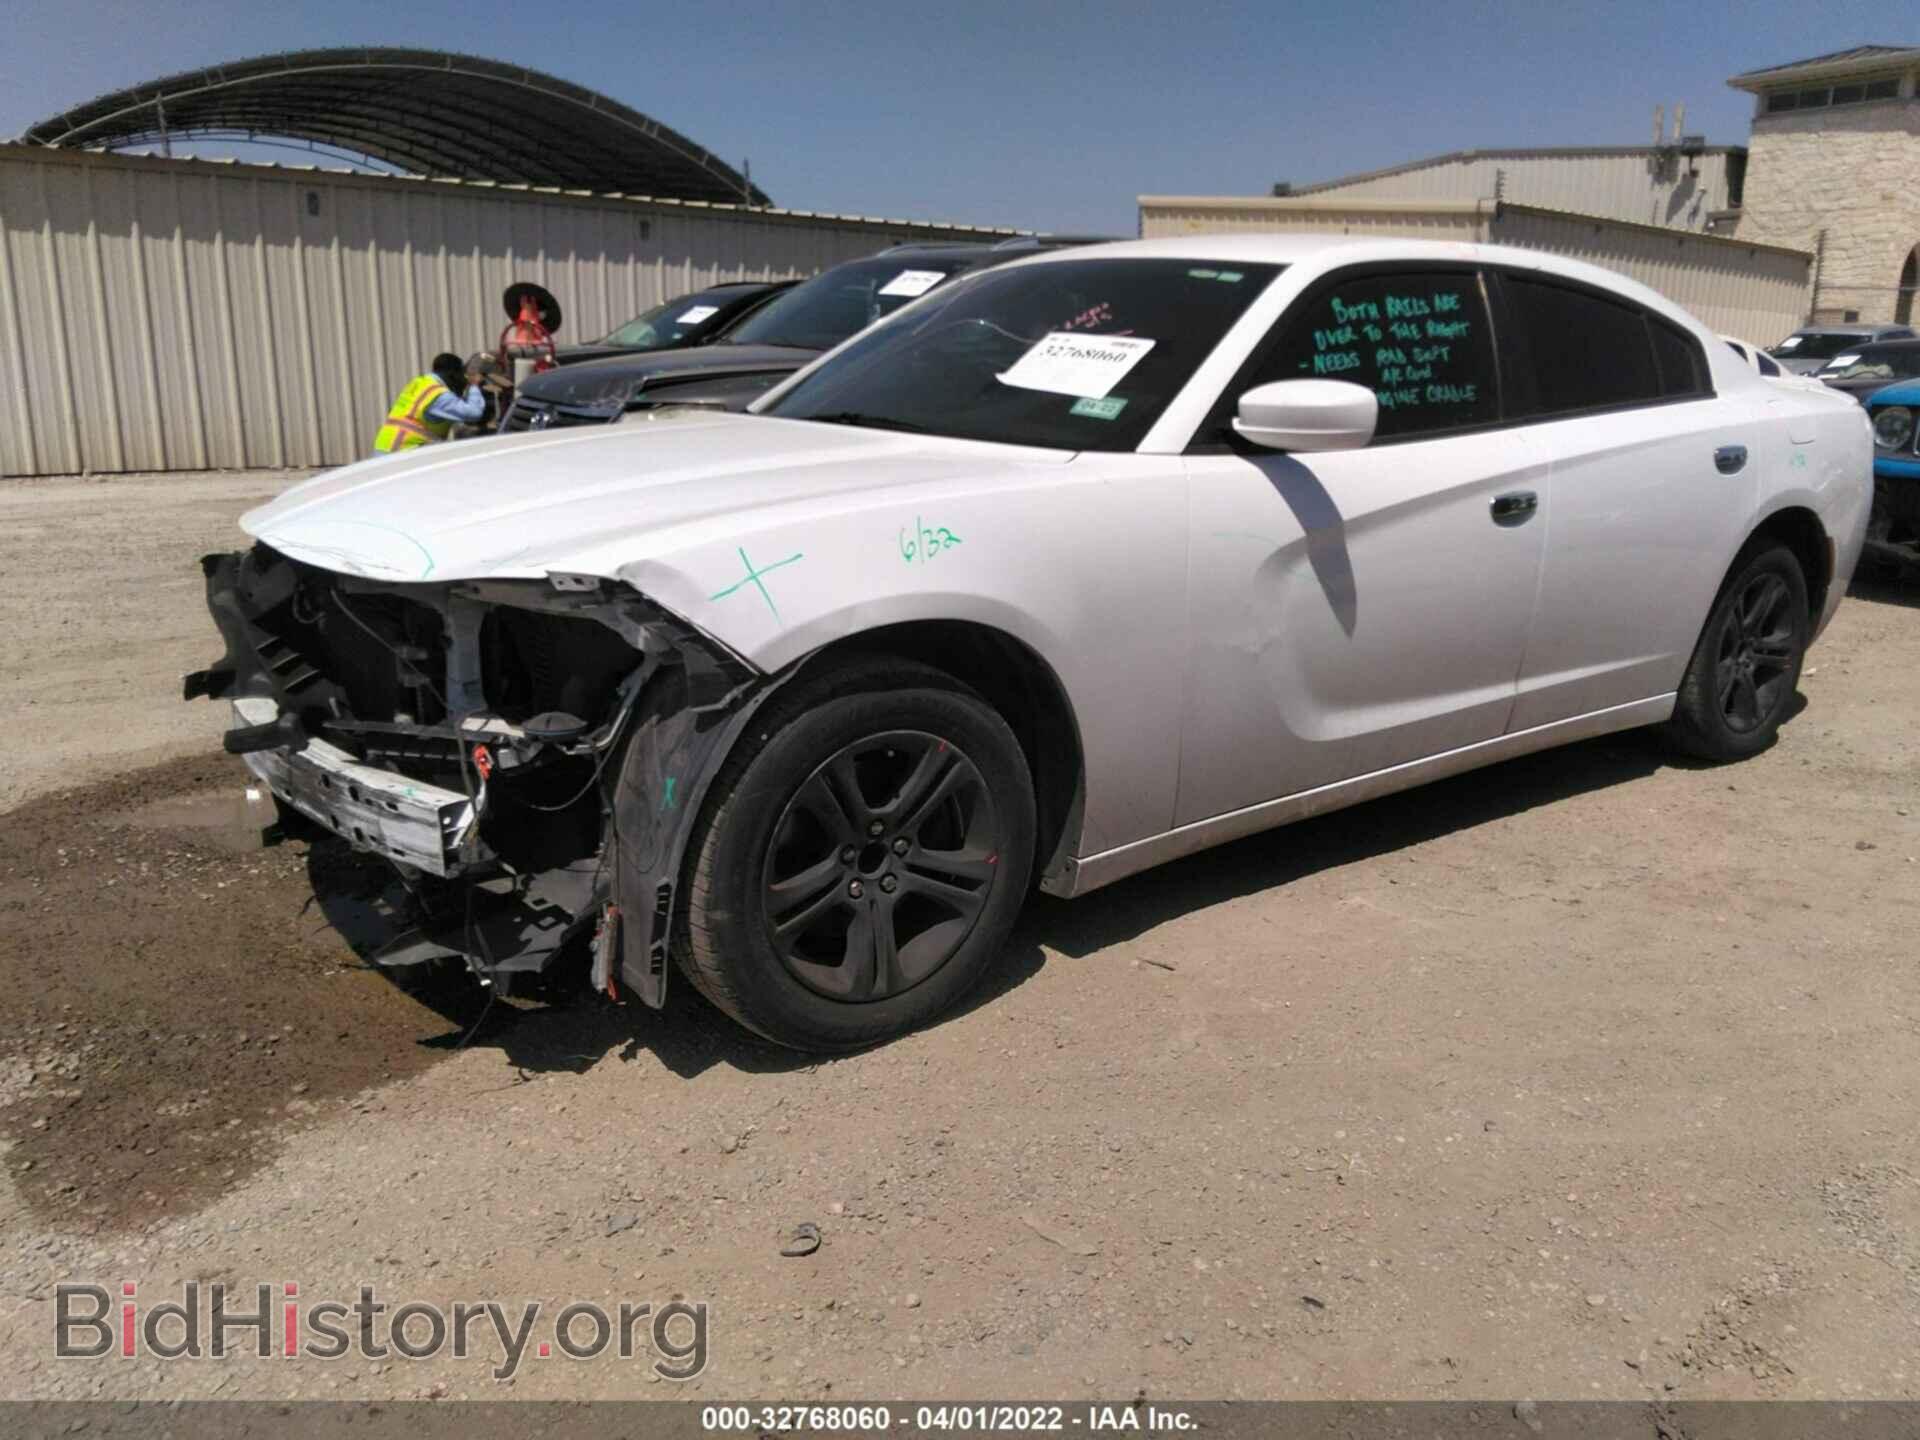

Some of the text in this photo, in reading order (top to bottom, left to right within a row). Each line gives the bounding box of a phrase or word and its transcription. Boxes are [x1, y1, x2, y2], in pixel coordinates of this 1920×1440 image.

[1363, 325, 1382, 342] TO
[1390, 321, 1421, 340] THE
[1314, 352, 1360, 374] NEEDS
[1376, 388, 1420, 409] NGINE
[899, 515, 963, 564] 6/32
